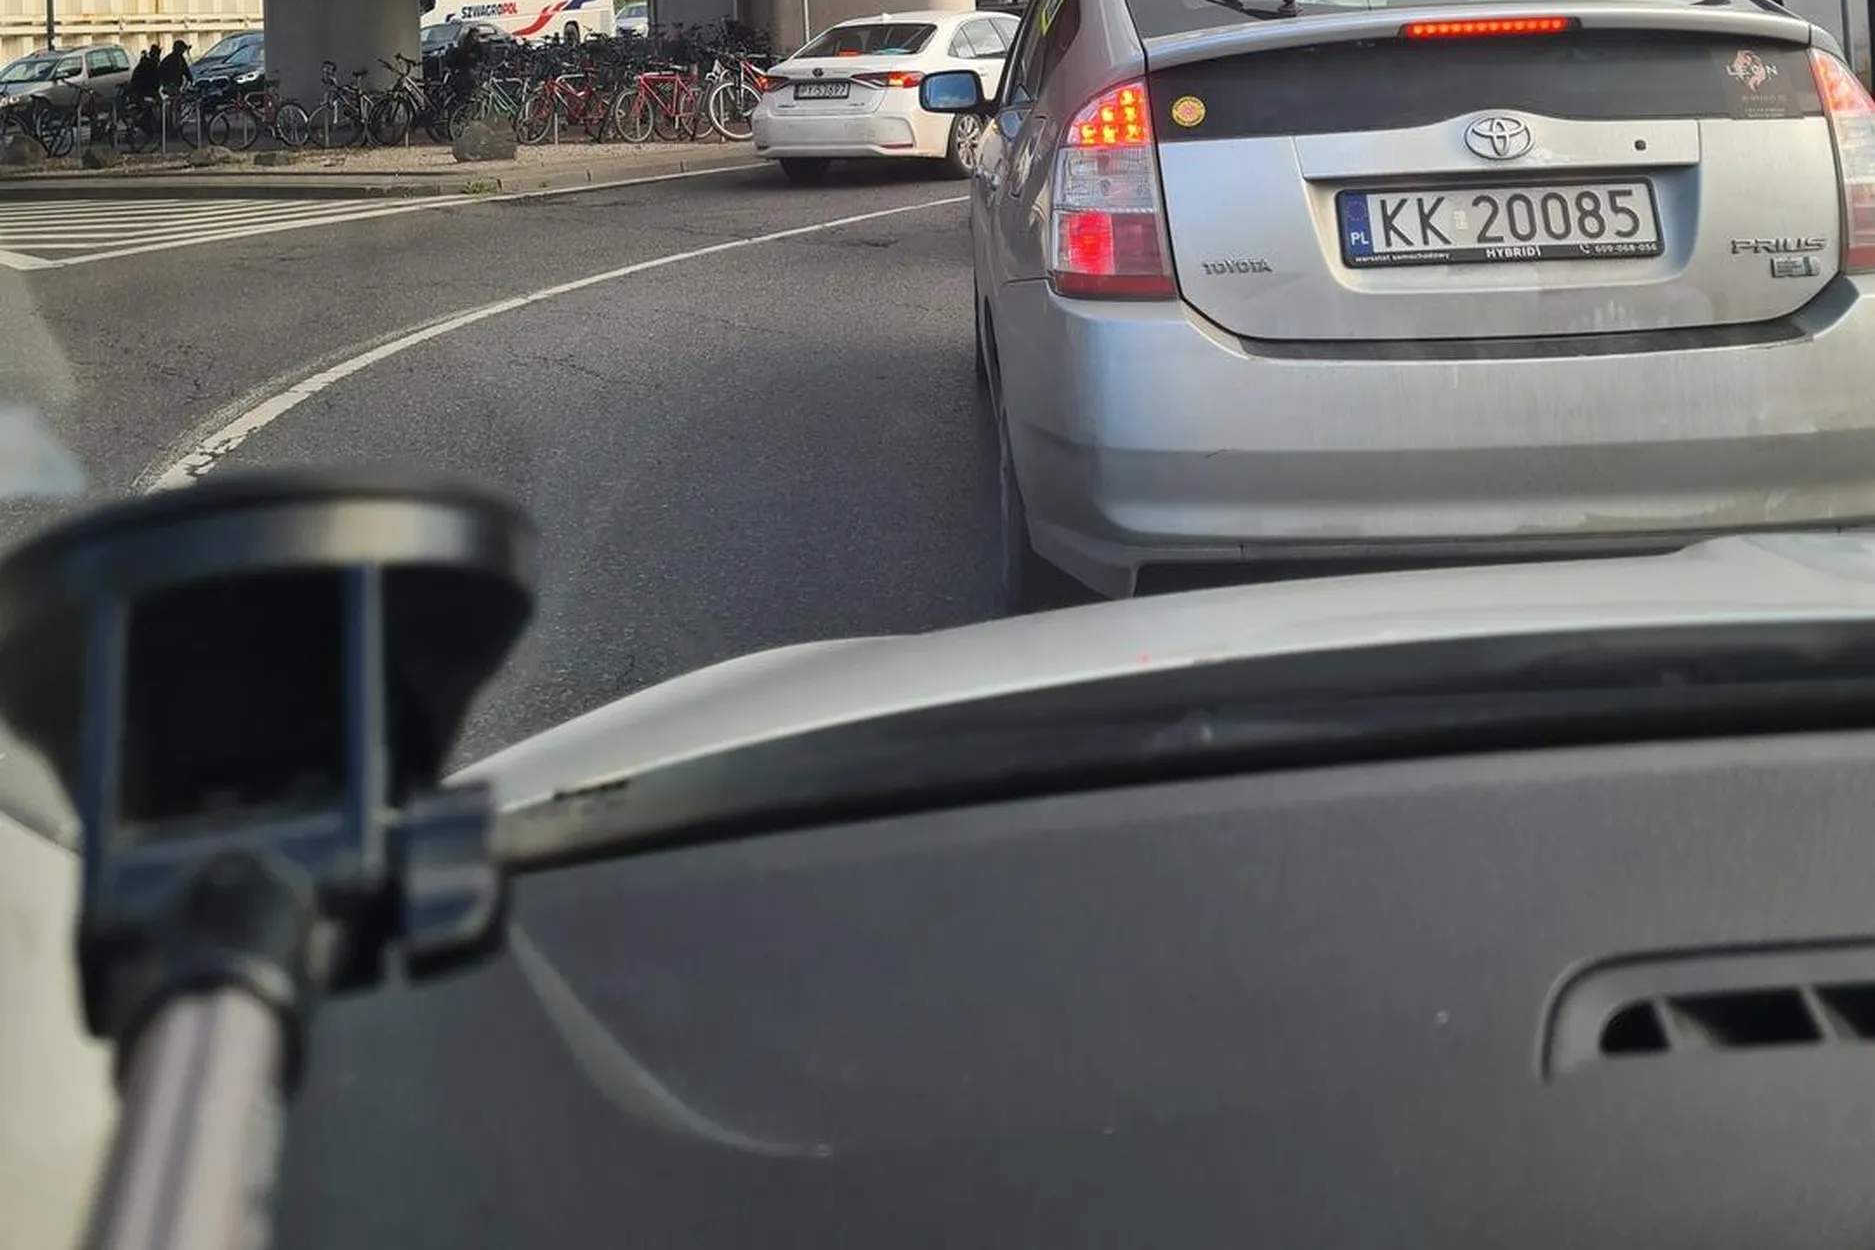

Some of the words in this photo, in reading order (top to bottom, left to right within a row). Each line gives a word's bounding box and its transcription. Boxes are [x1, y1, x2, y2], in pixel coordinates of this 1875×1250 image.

[461, 2, 518, 19] SZWAGROPOL
[1380, 196, 1452, 247] KK
[1471, 189, 1641, 244] 20085
[1351, 231, 1369, 246] PL
[1730, 237, 1828, 254] PRIUS
[1202, 258, 1273, 275] TOYOTA
